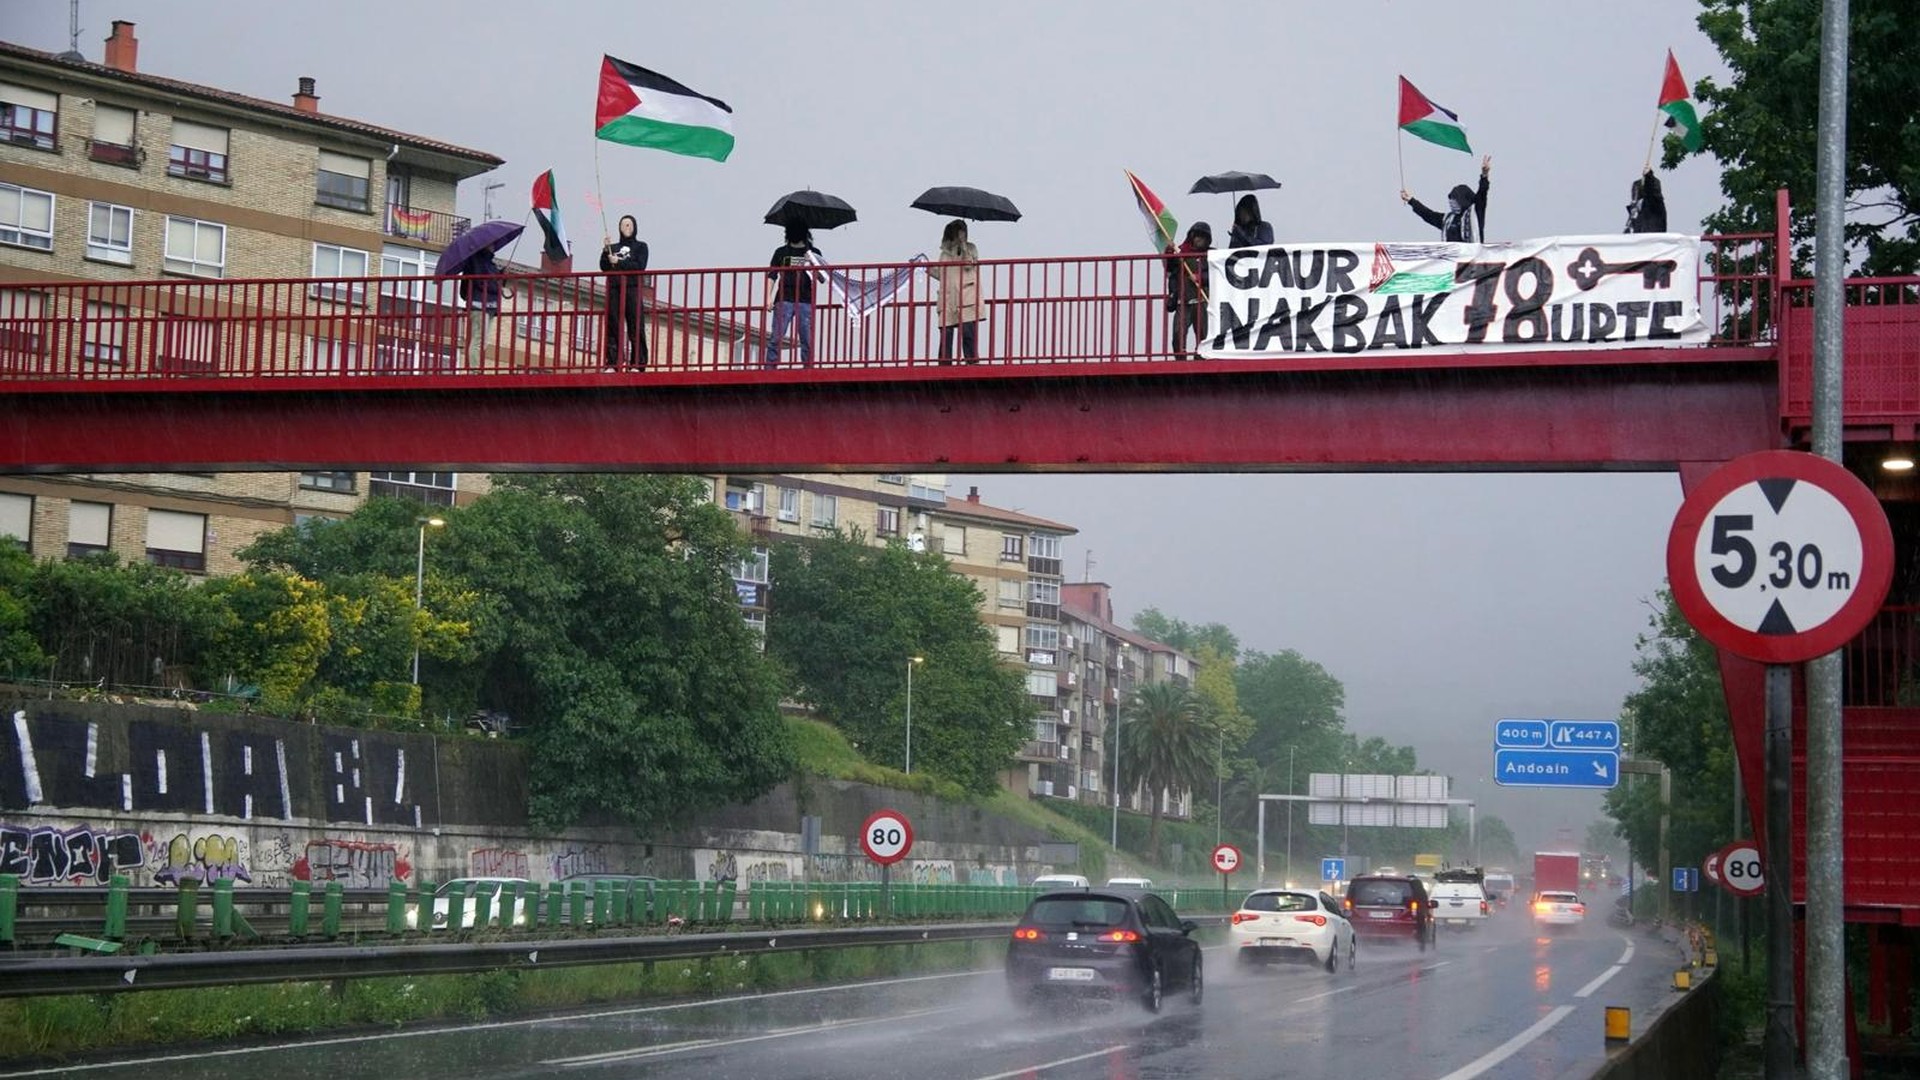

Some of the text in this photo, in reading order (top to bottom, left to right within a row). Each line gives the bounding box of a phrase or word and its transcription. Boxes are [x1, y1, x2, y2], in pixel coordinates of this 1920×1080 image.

[1224, 249, 1360, 293] GAUR
[1213, 257, 1682, 353] NAKBAK 78 URTE
[1502, 729, 1528, 738] 400
[1505, 762, 1569, 774] Andoain
[873, 828, 900, 845] 80
[1730, 860, 1762, 878] 80
